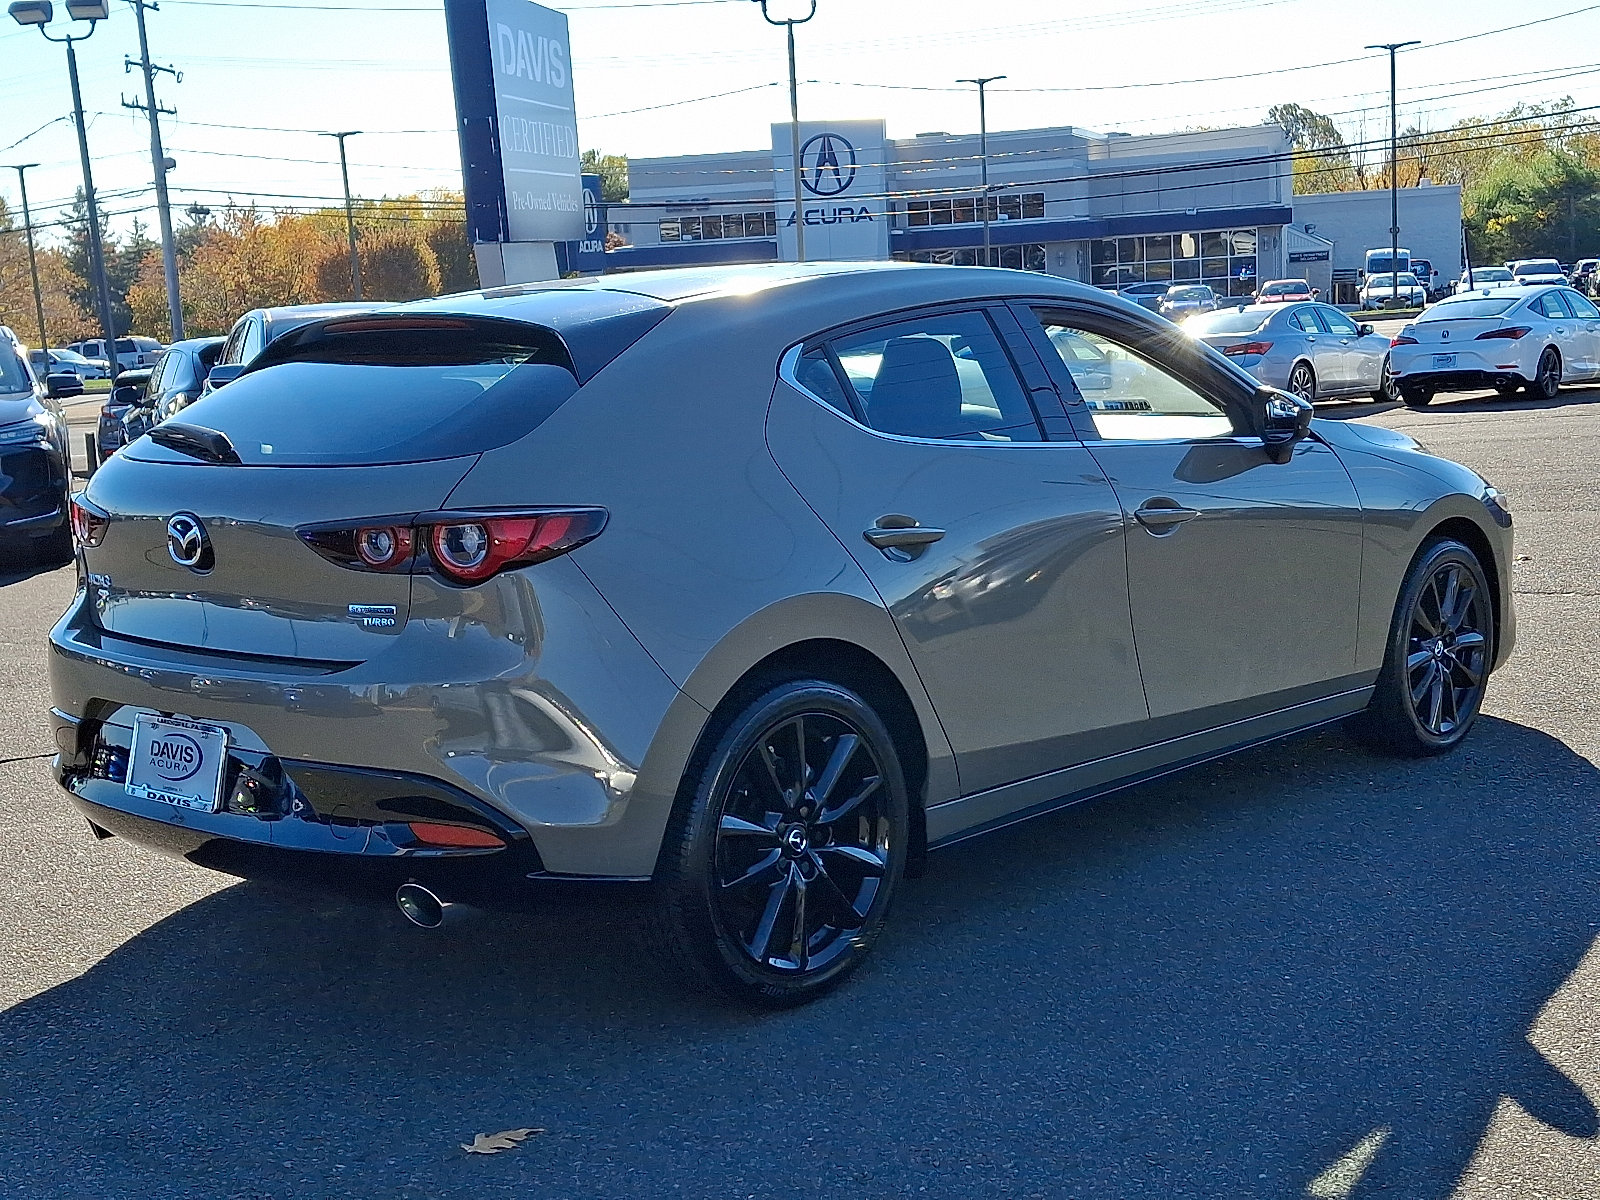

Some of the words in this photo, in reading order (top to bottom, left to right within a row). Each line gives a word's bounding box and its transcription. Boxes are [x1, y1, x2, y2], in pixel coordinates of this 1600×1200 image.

[496, 22, 566, 88] DAVIS
[502, 114, 575, 159] CERTIFIED
[512, 190, 552, 211] Pre-Owned
[551, 193, 579, 212] Vehicles
[786, 206, 874, 227] ACURA
[579, 240, 603, 253] ACURA
[362, 617, 395, 627] TURBO
[150, 740, 194, 763] DAVIS
[149, 758, 189, 773] ACURA
[146, 791, 191, 808] DAVIS
